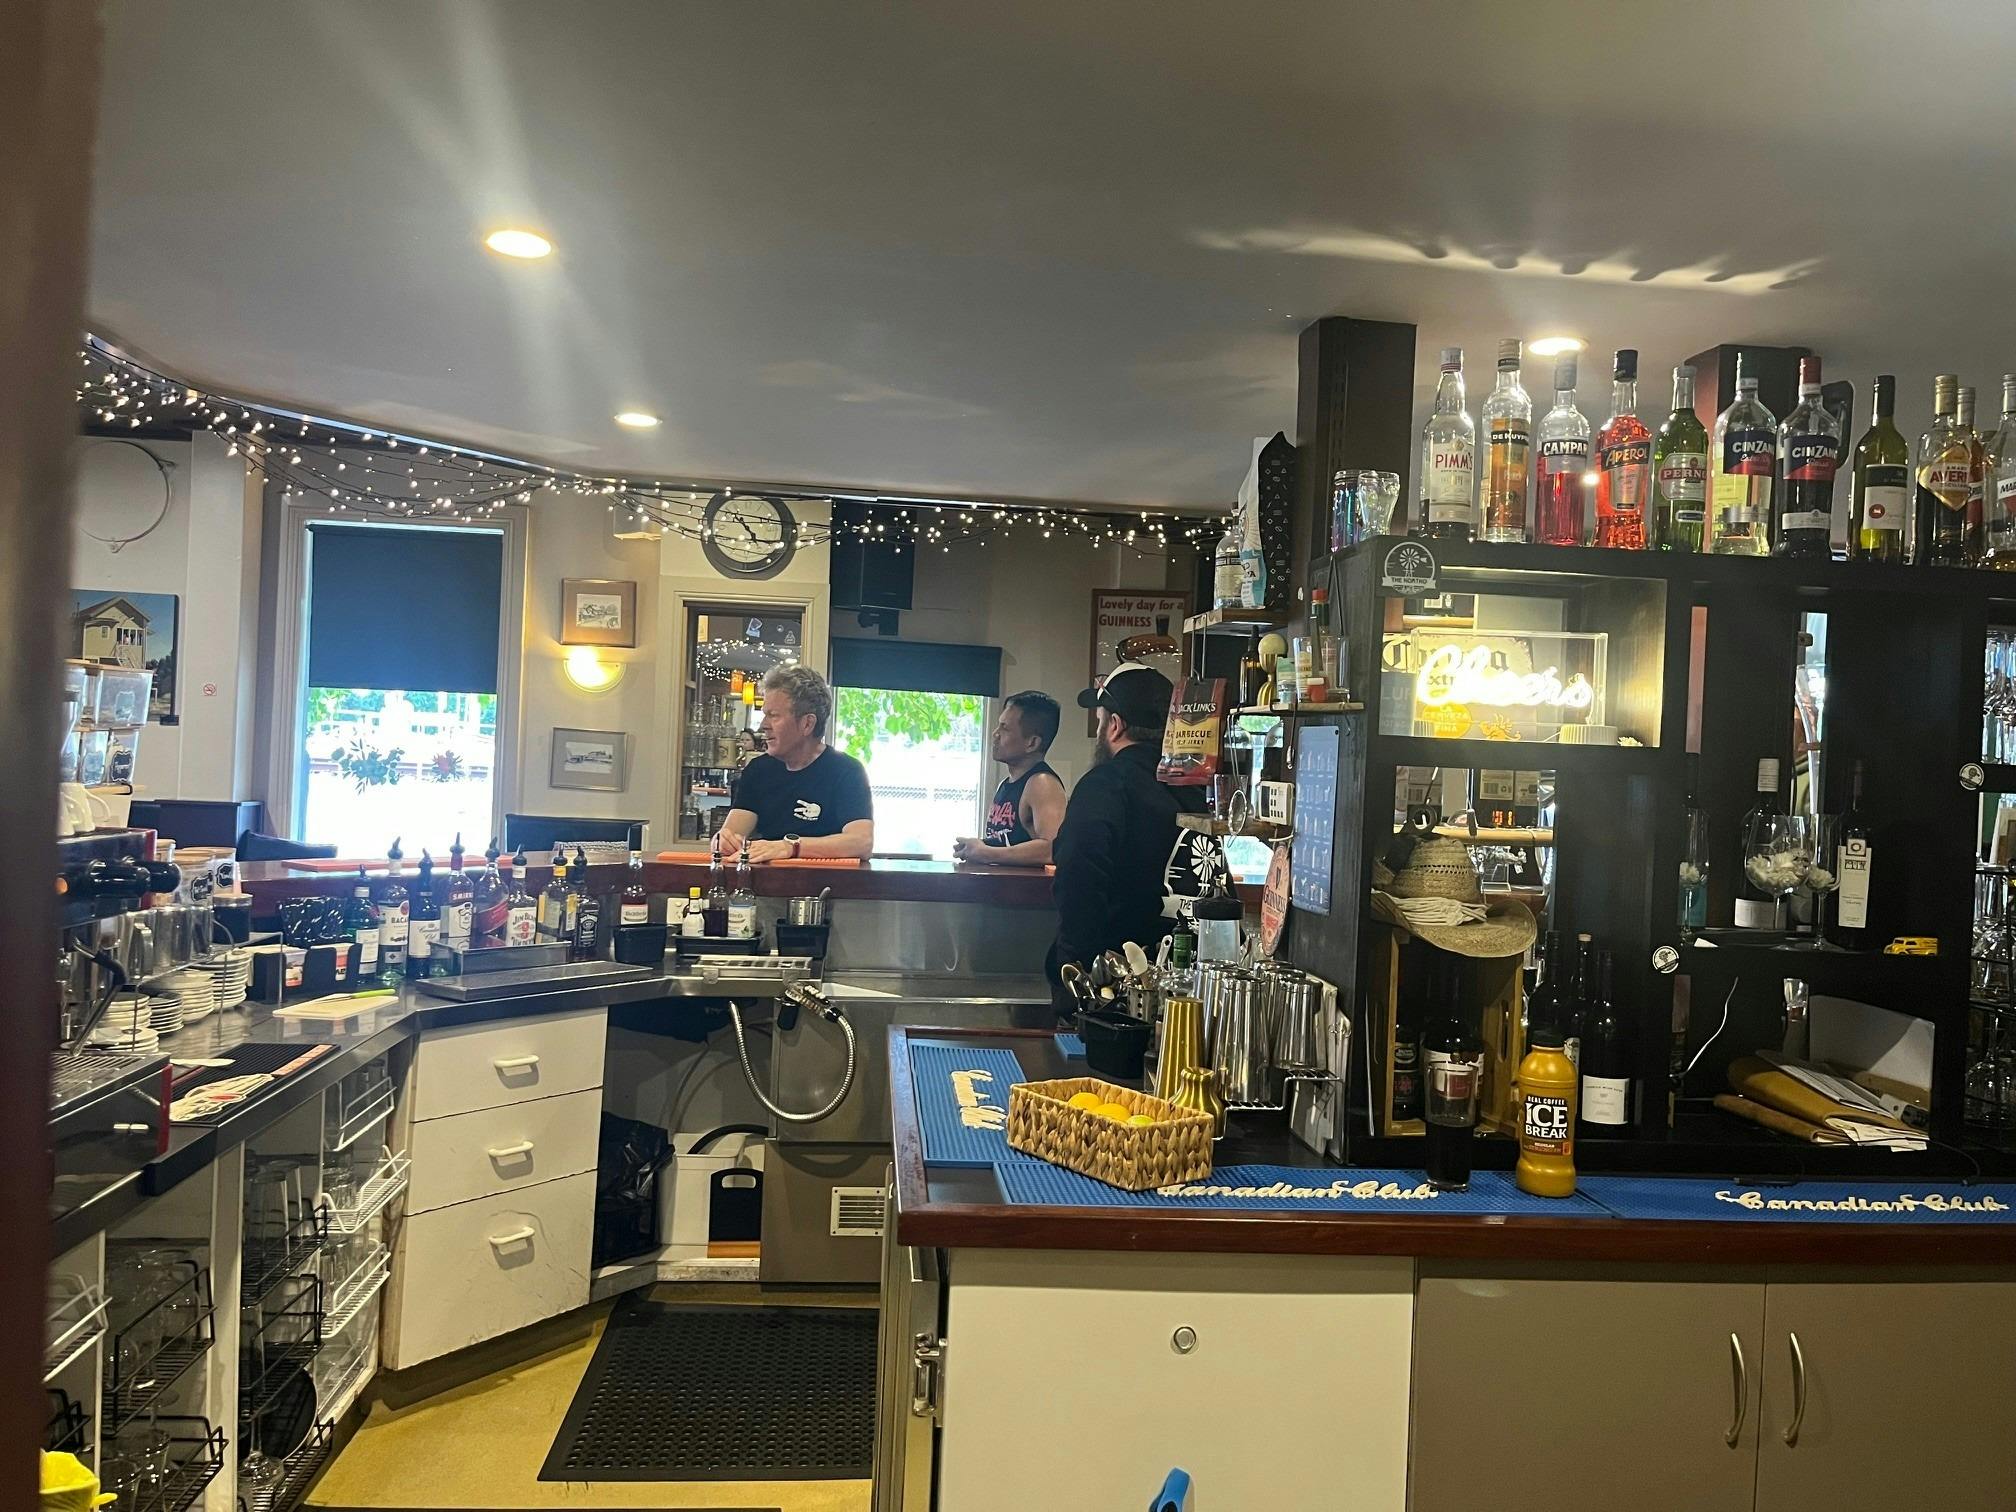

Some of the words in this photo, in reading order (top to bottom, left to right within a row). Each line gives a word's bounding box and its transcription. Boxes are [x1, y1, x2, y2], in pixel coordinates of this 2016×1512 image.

[1100, 598, 1133, 611] Lovely
[1136, 600, 1155, 612] day
[1159, 600, 1174, 609] for
[1099, 614, 1151, 627] GUINNESS
[1543, 1098, 1565, 1106] COFFEE
[1525, 1102, 1568, 1128] ICE
[1525, 1124, 1567, 1139] BREAK
[1715, 1190, 1917, 1212] Canadian
[1918, 1193, 2010, 1213] Club
